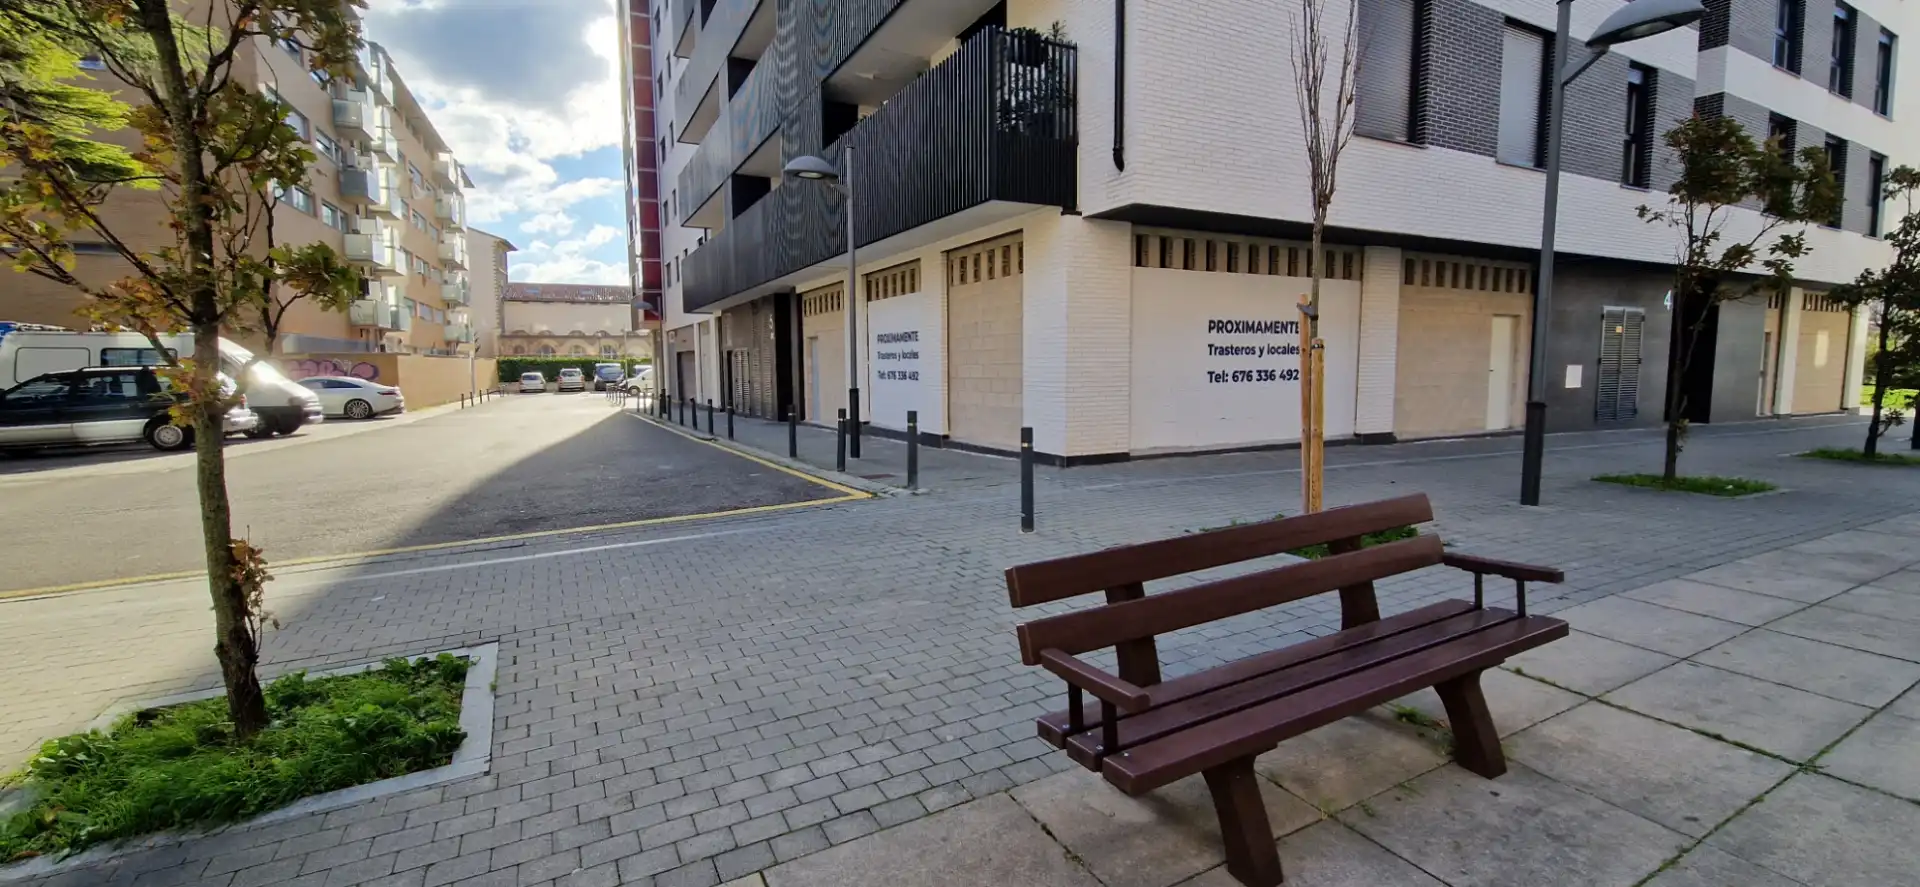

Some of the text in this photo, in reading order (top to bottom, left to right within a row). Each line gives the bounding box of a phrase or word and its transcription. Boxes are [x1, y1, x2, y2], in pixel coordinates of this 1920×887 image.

[1664, 289, 1672, 311] 4
[1208, 319, 1299, 334] PROXIMAMENTE
[877, 331, 919, 344] PROXIMAMENTE
[877, 351, 897, 360] Trasteros
[902, 349, 919, 360] locales
[1208, 343, 1300, 358] Trasteros y locales
[877, 370, 919, 381] Tel: 676 336 492
[1207, 368, 1299, 383] Tel: 676 336 492
